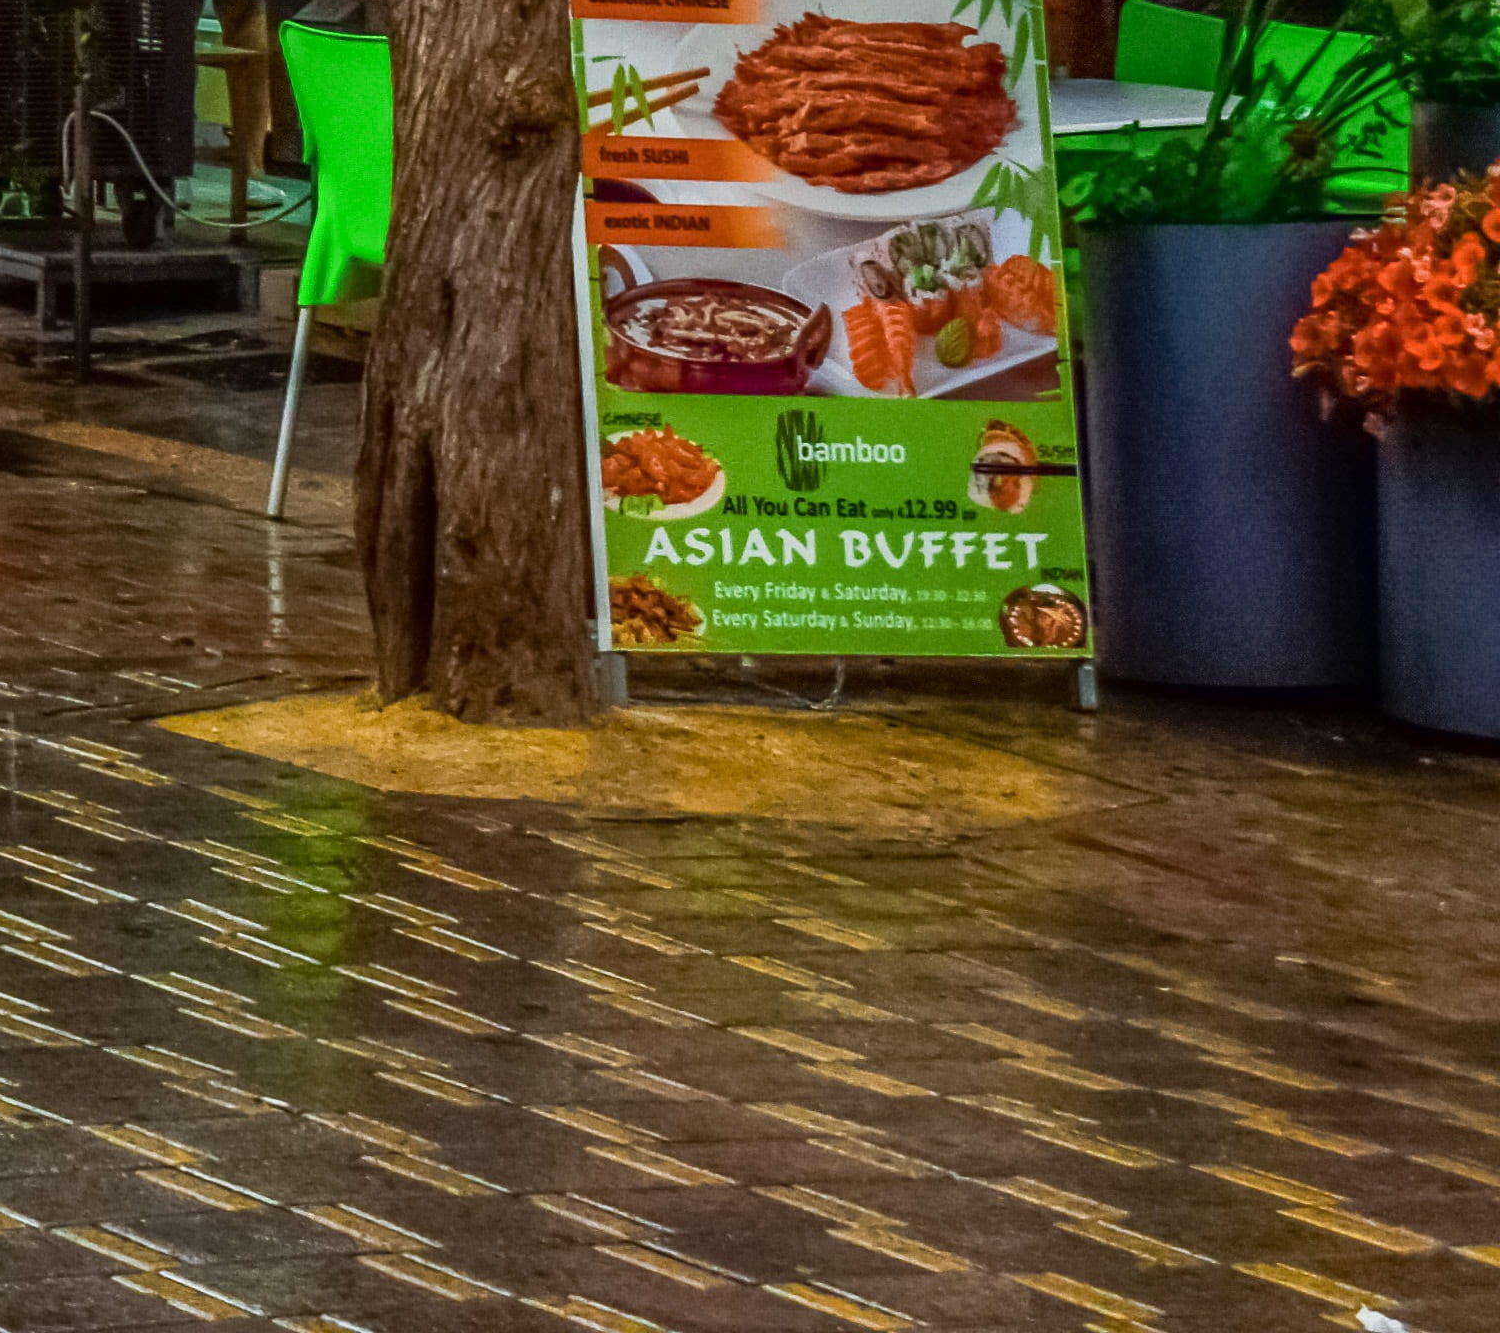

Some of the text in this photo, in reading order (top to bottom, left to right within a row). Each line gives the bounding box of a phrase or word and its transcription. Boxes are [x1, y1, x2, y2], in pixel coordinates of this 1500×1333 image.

[599, 146, 689, 165] fresh SUSHI
[604, 214, 710, 231] exotic INDIAN
[796, 435, 906, 464] bamboo
[722, 495, 749, 515] All
[753, 496, 788, 516] You
[794, 497, 831, 517] Can
[837, 498, 867, 518] Eat
[643, 526, 1048, 570] ASIAN BUFFET
[714, 582, 760, 601] Every
[765, 582, 817, 602] Friday
[712, 609, 758, 630] Every
[763, 610, 837, 630] Saturday
